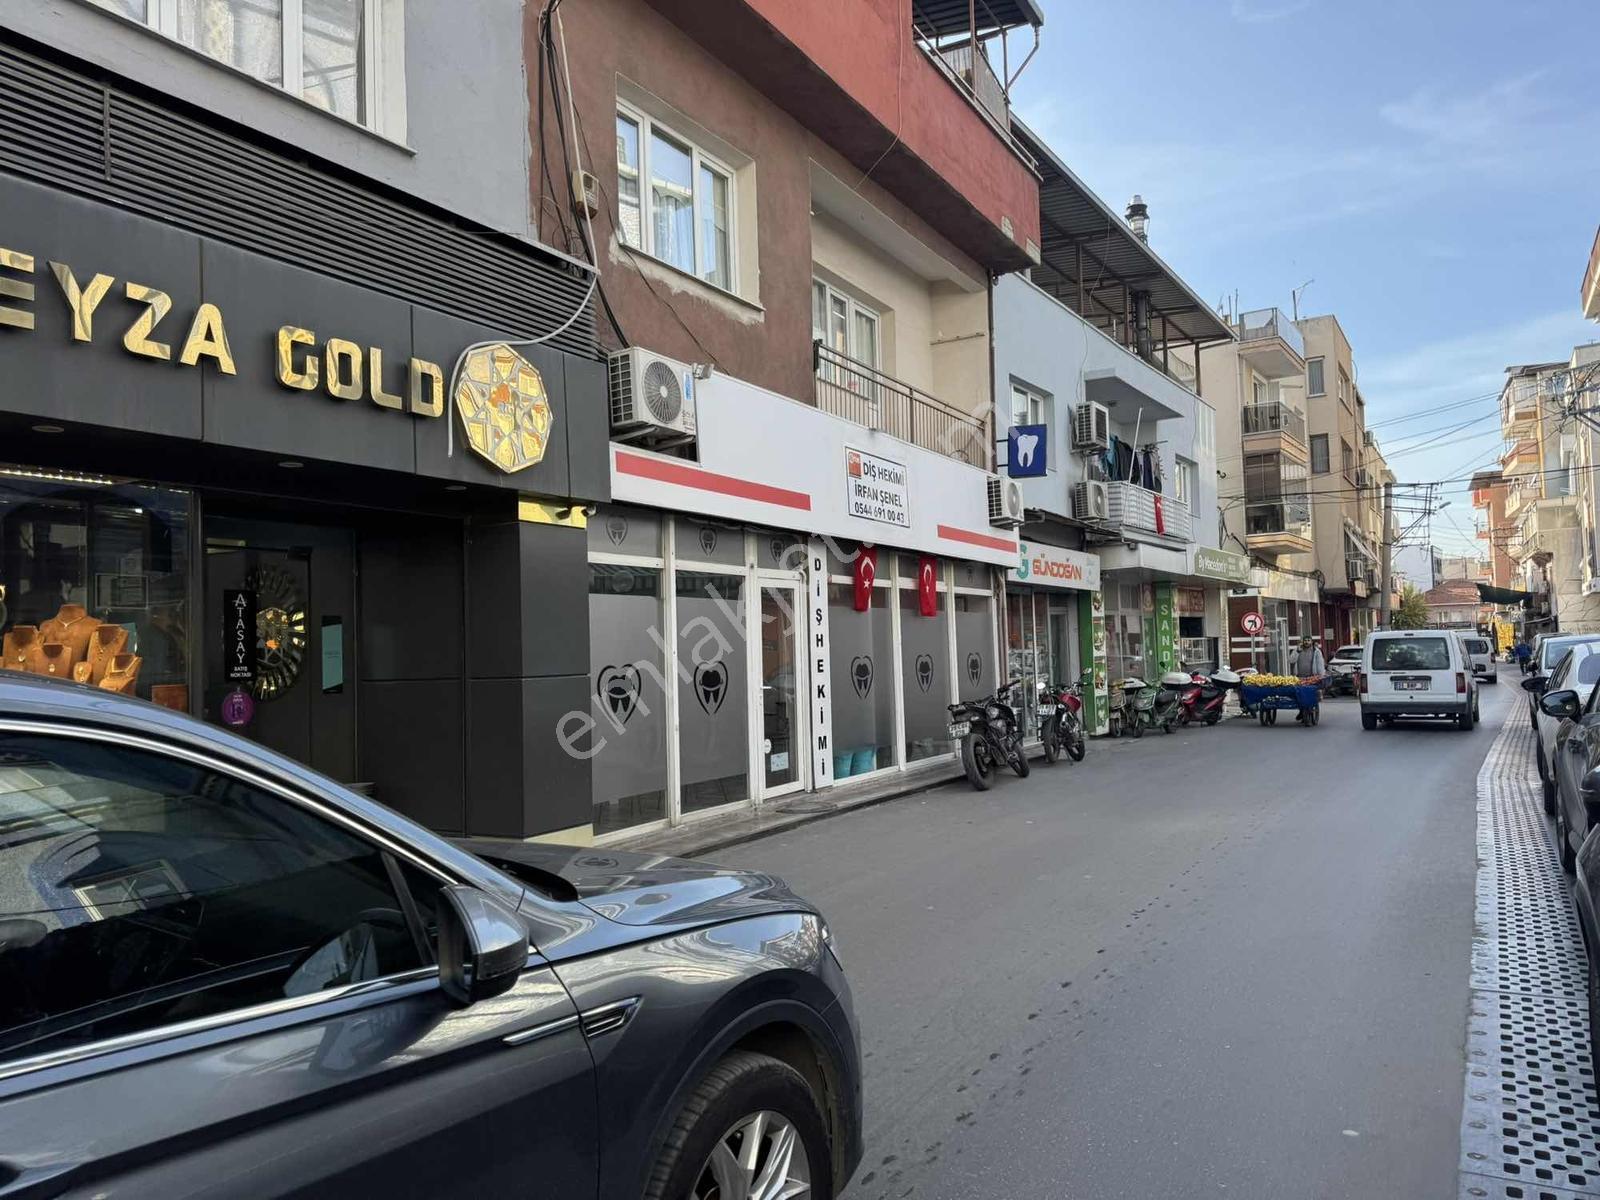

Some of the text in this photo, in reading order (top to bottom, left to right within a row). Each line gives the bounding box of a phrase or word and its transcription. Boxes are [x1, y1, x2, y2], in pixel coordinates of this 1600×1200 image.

[276, 325, 444, 418] GOLD
[863, 460, 905, 486] DİŞ HEKİMİ
[854, 480, 903, 507] İRFAN ŞENEL
[854, 501, 905, 524] 0544 691 00 43
[1032, 553, 1082, 580] GÜNDOĞAN
[232, 593, 248, 664] ATASAY
